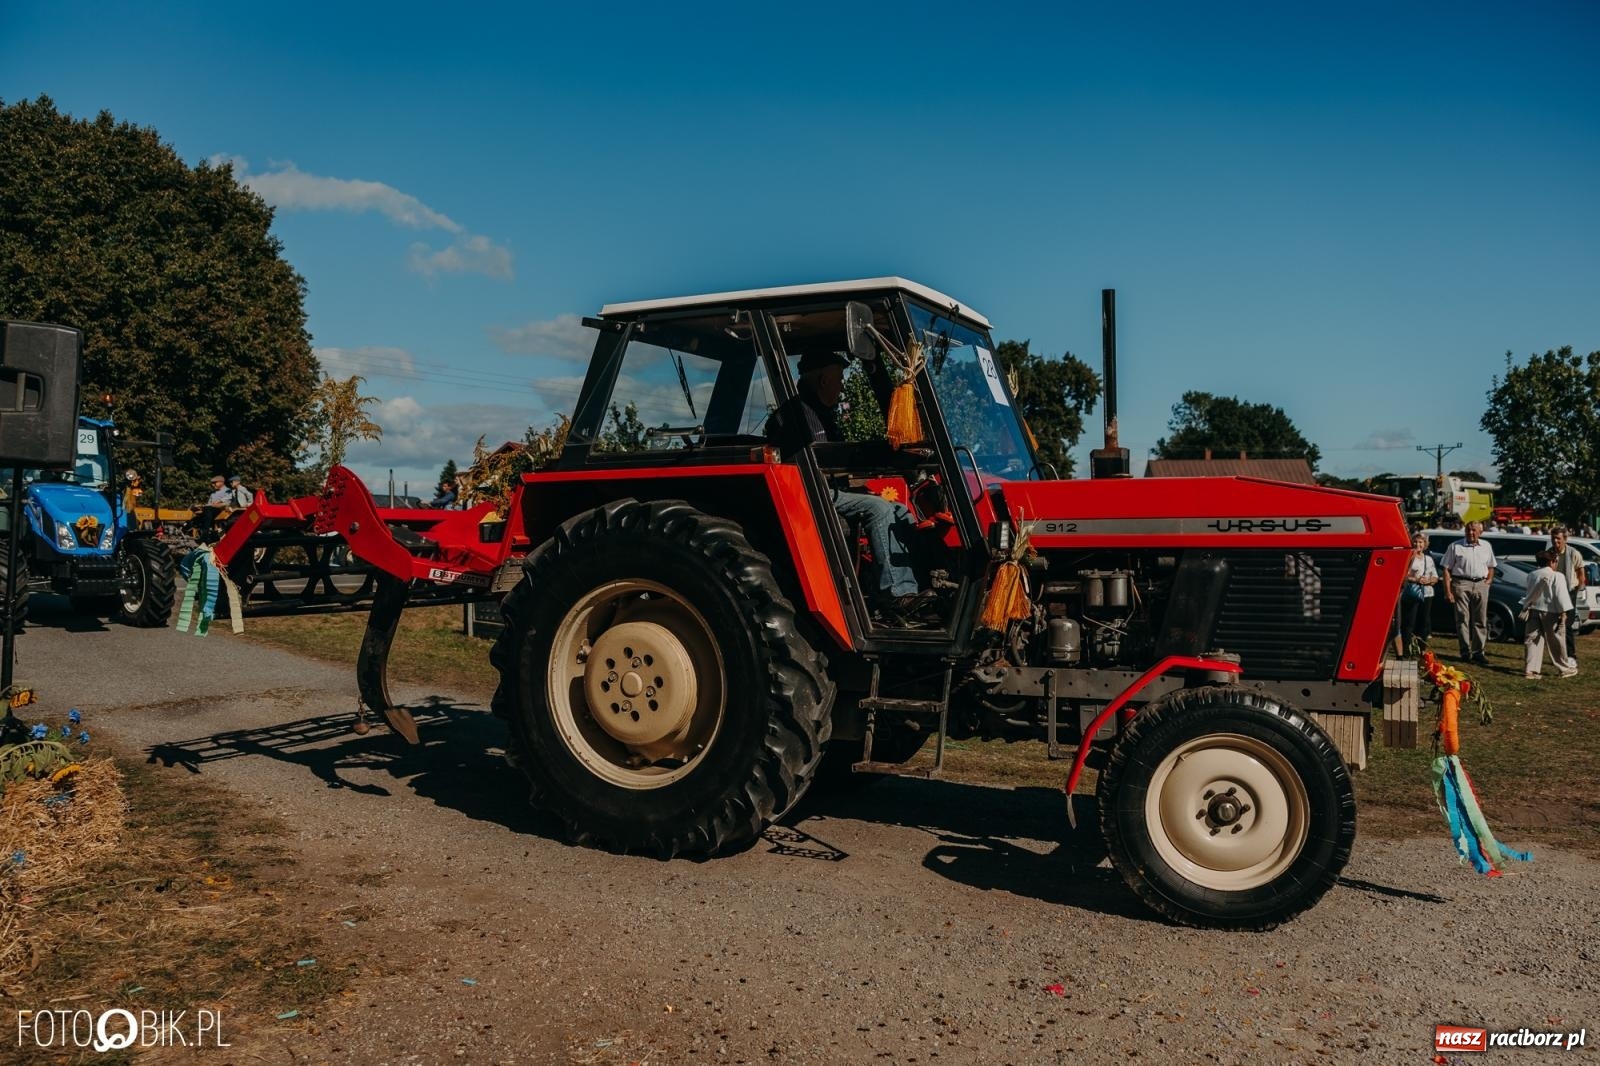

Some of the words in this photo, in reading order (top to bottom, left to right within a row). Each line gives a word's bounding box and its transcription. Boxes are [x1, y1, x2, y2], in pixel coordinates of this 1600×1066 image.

[79, 433, 95, 444] 29
[1045, 522, 1078, 533] 912
[1214, 519, 1324, 532] URSUS
